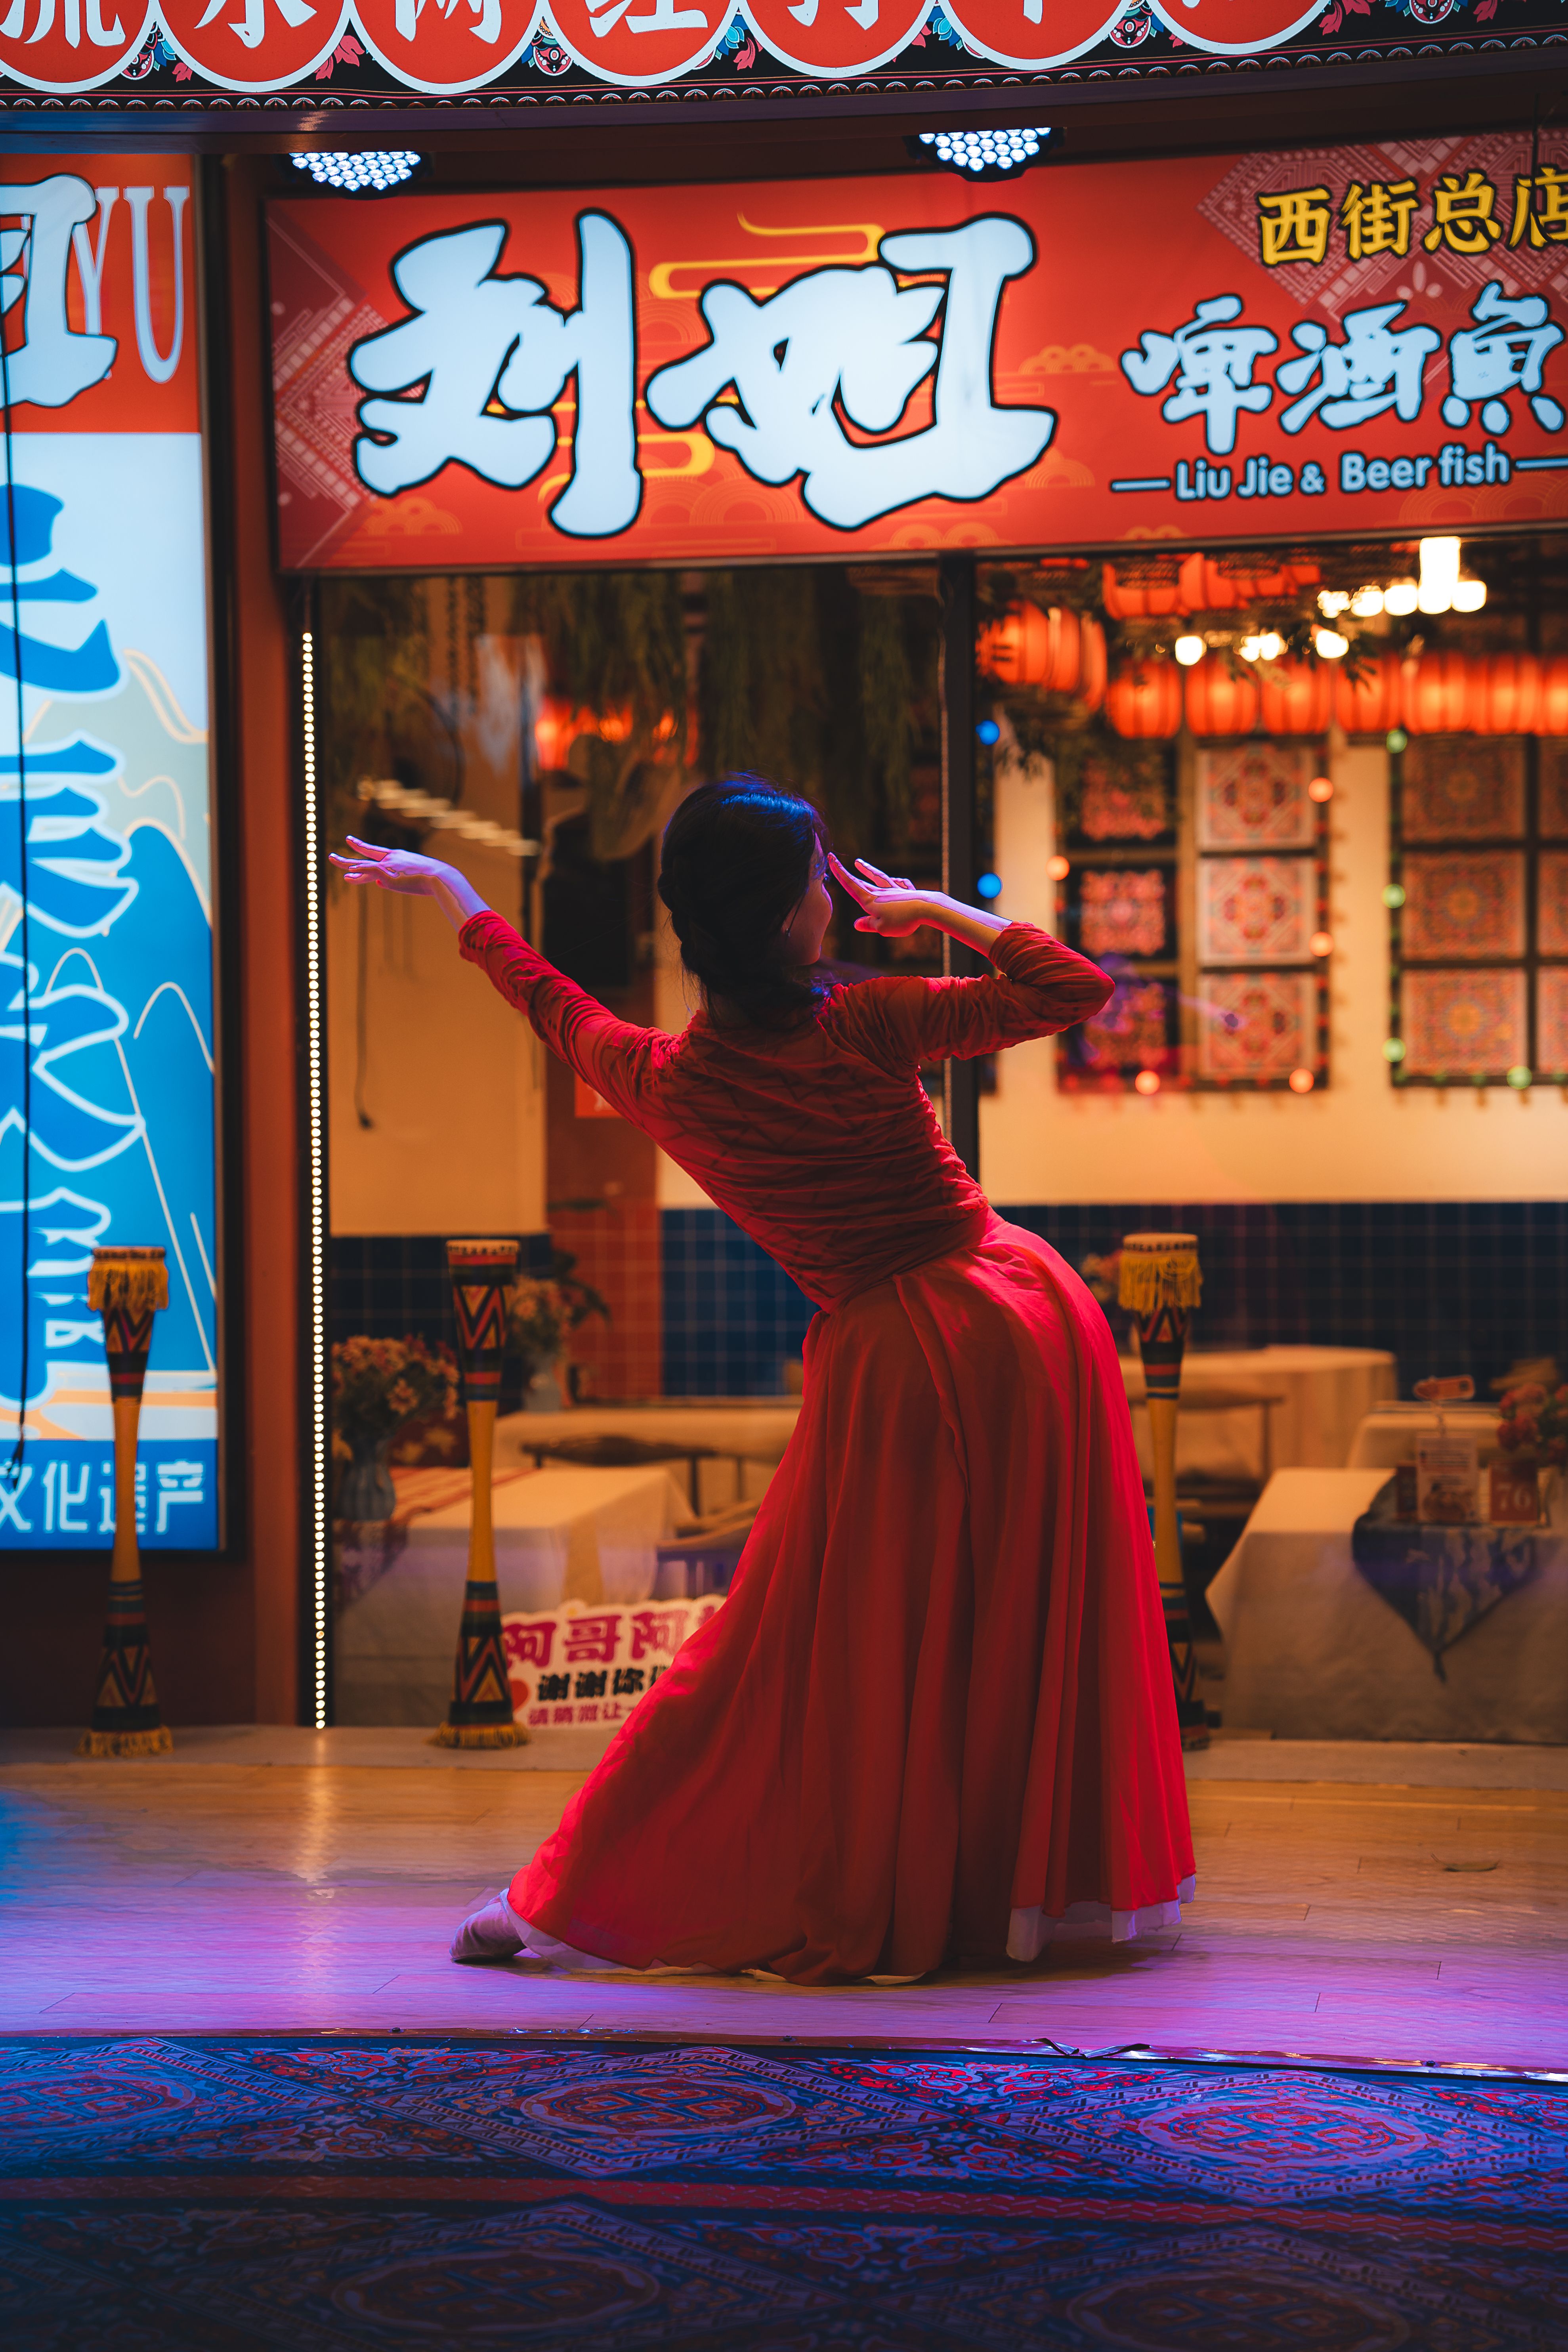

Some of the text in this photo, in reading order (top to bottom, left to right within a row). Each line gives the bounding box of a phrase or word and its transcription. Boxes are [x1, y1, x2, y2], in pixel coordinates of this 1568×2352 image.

[1258, 167, 1568, 265] 西街总店
[350, 210, 1056, 536] 刘姐
[1122, 281, 1564, 454] 啤酒鱼
[1176, 442, 1510, 500] Liu Jie & Beer fish
[502, 1606, 716, 1670] 阿哥阿
